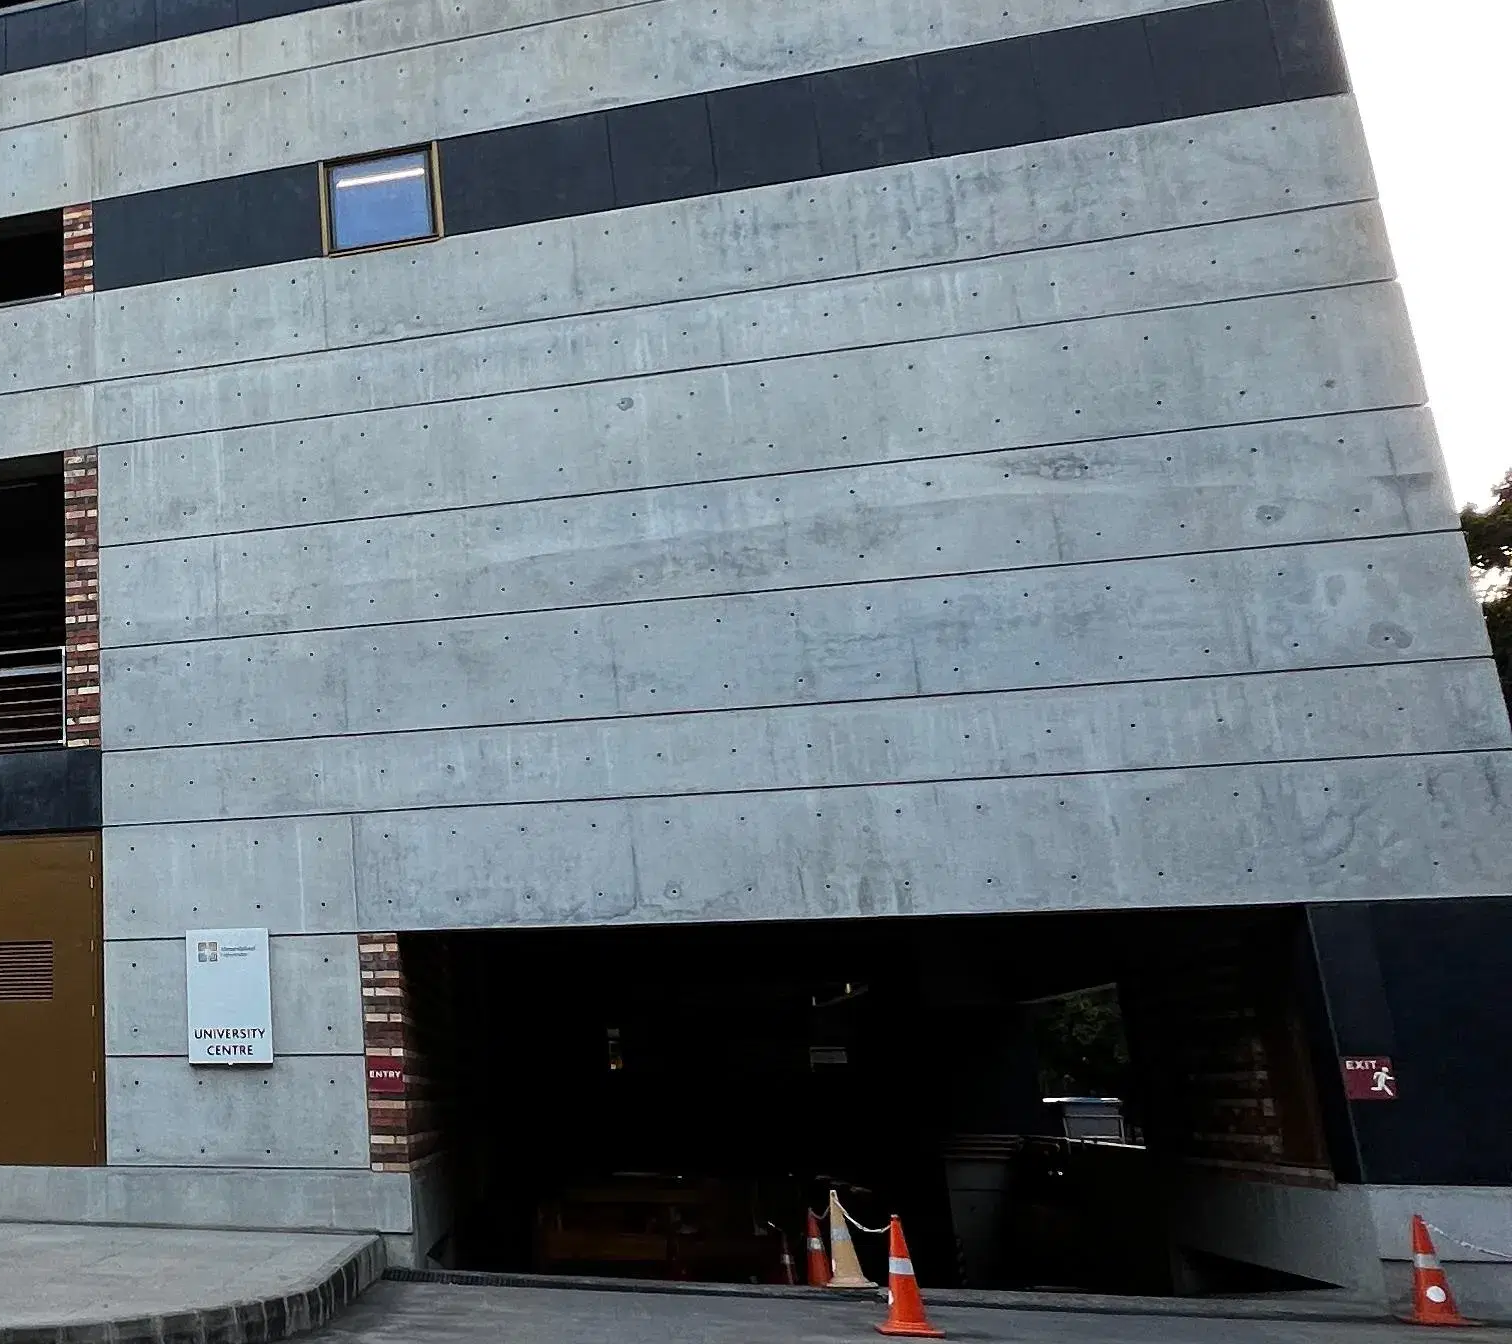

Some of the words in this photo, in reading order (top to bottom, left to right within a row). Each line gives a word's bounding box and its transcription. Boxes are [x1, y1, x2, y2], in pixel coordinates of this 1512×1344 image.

[194, 1028, 265, 1039] UNIVERSITY
[207, 1044, 254, 1055] CENTRE
[1346, 1060, 1377, 1070] EXIT
[369, 1070, 400, 1078] ENTRY
